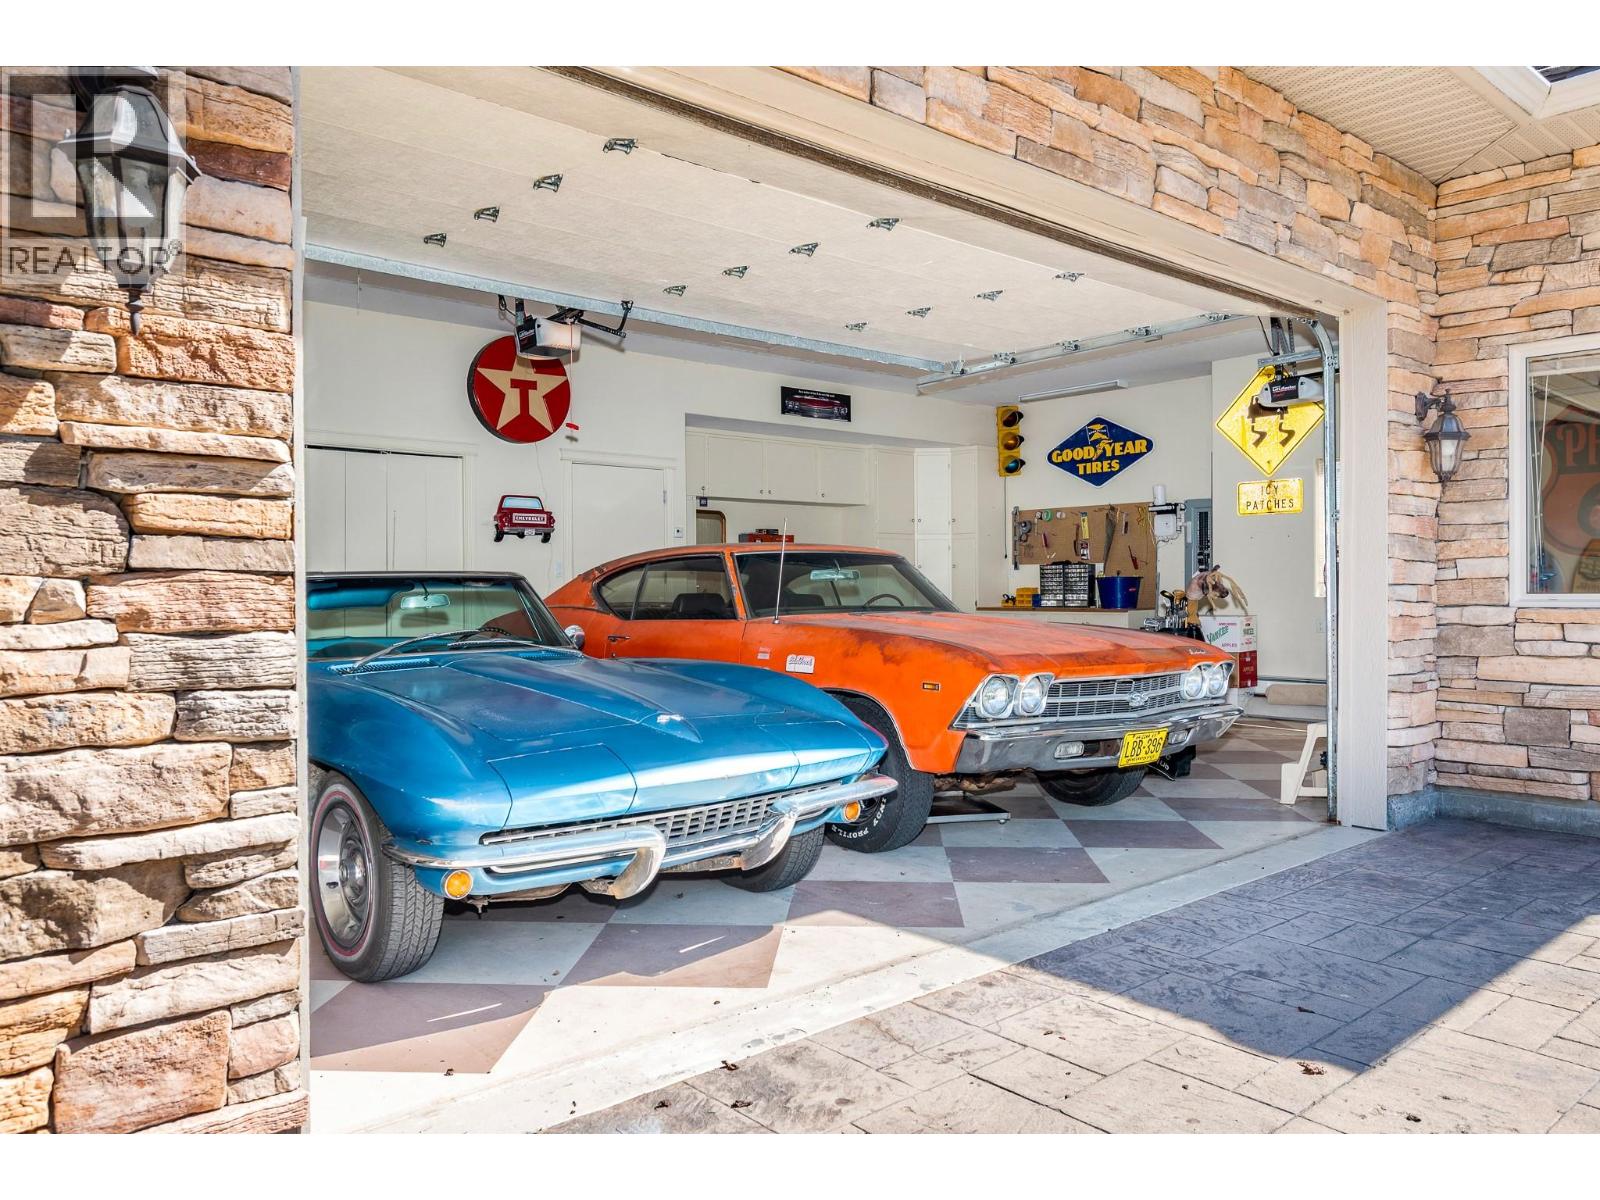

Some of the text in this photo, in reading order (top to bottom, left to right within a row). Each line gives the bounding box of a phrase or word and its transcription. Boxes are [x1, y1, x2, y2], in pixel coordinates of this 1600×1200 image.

[510, 378, 538, 415] T
[1076, 460, 1120, 475] TIRES
[1260, 485, 1279, 496] ICY
[1246, 498, 1295, 511] PATCHES
[831, 824, 869, 839] PROFILE
